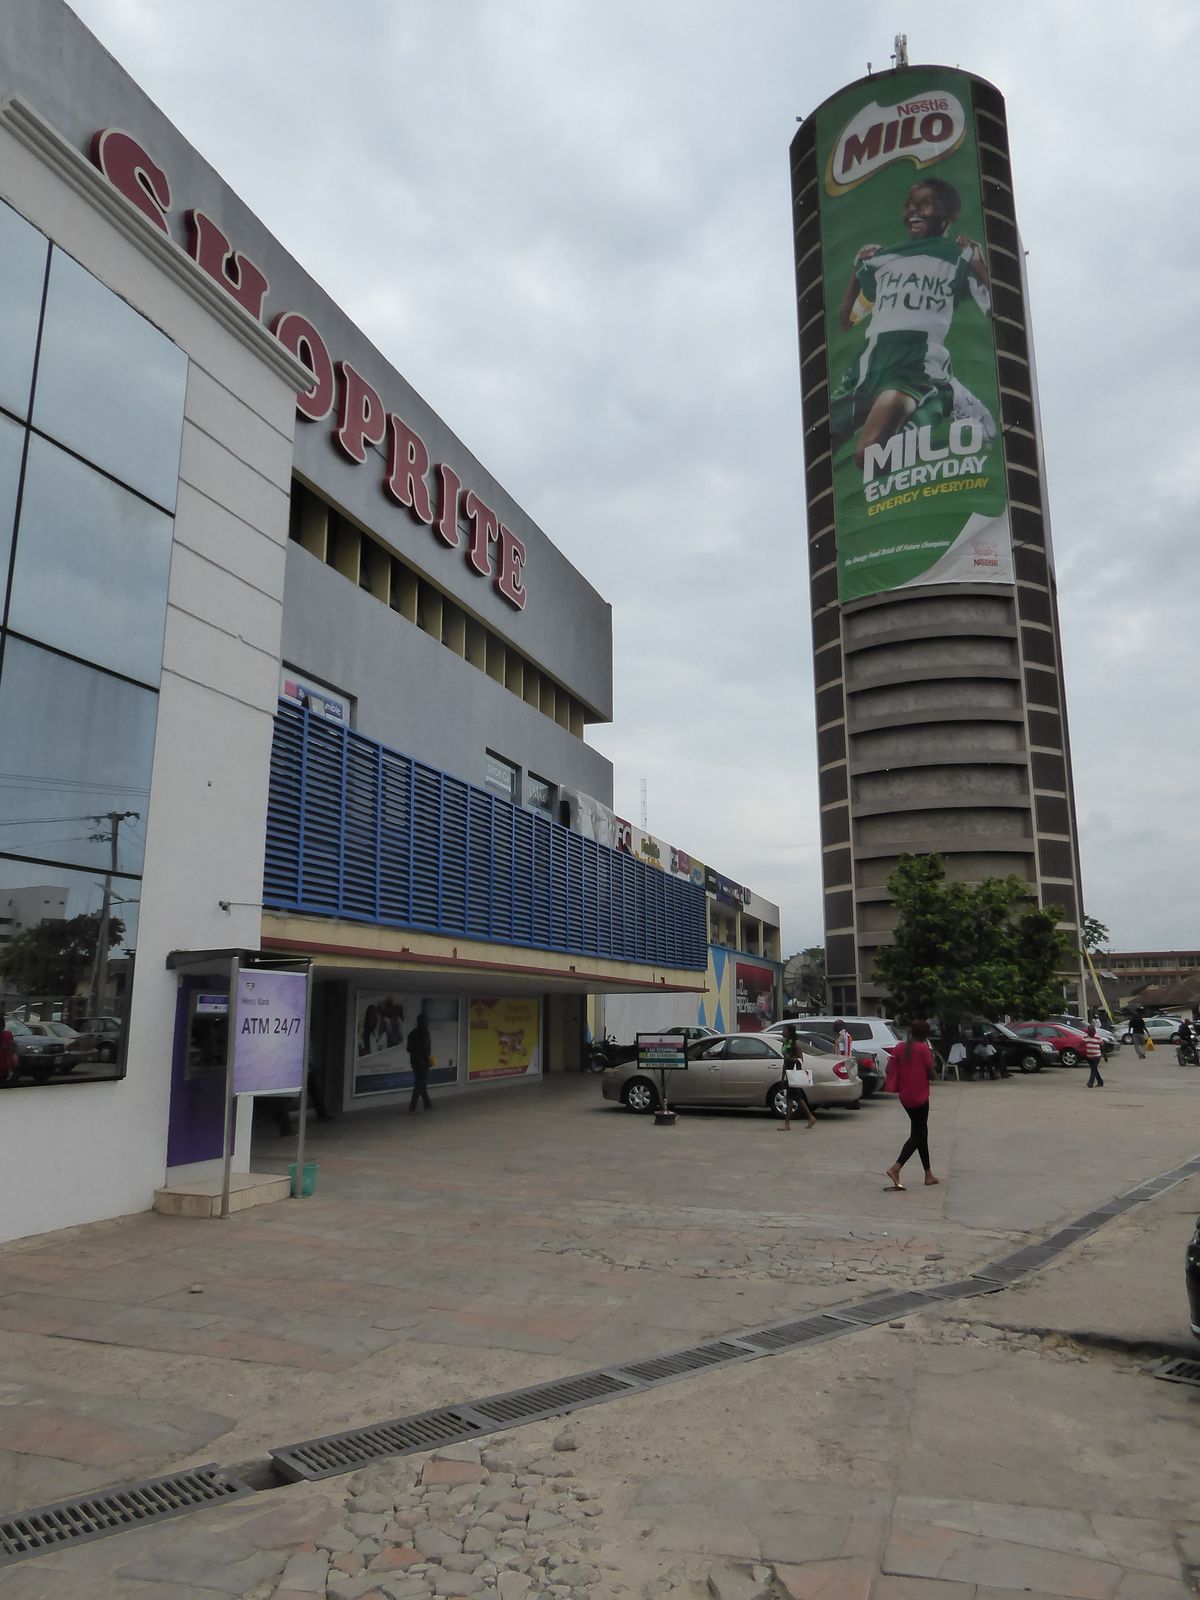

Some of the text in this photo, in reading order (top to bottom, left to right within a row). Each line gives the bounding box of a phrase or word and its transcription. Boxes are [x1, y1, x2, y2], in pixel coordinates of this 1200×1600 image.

[841, 113, 954, 174] MILO
[878, 291, 947, 311] MUM
[879, 272, 955, 298] THANKS
[863, 418, 982, 485] MILO
[864, 455, 988, 503] EVERYDAY
[868, 477, 989, 516] ENERGY EVERYDAY
[241, 1017, 301, 1036] ATM 24/7
